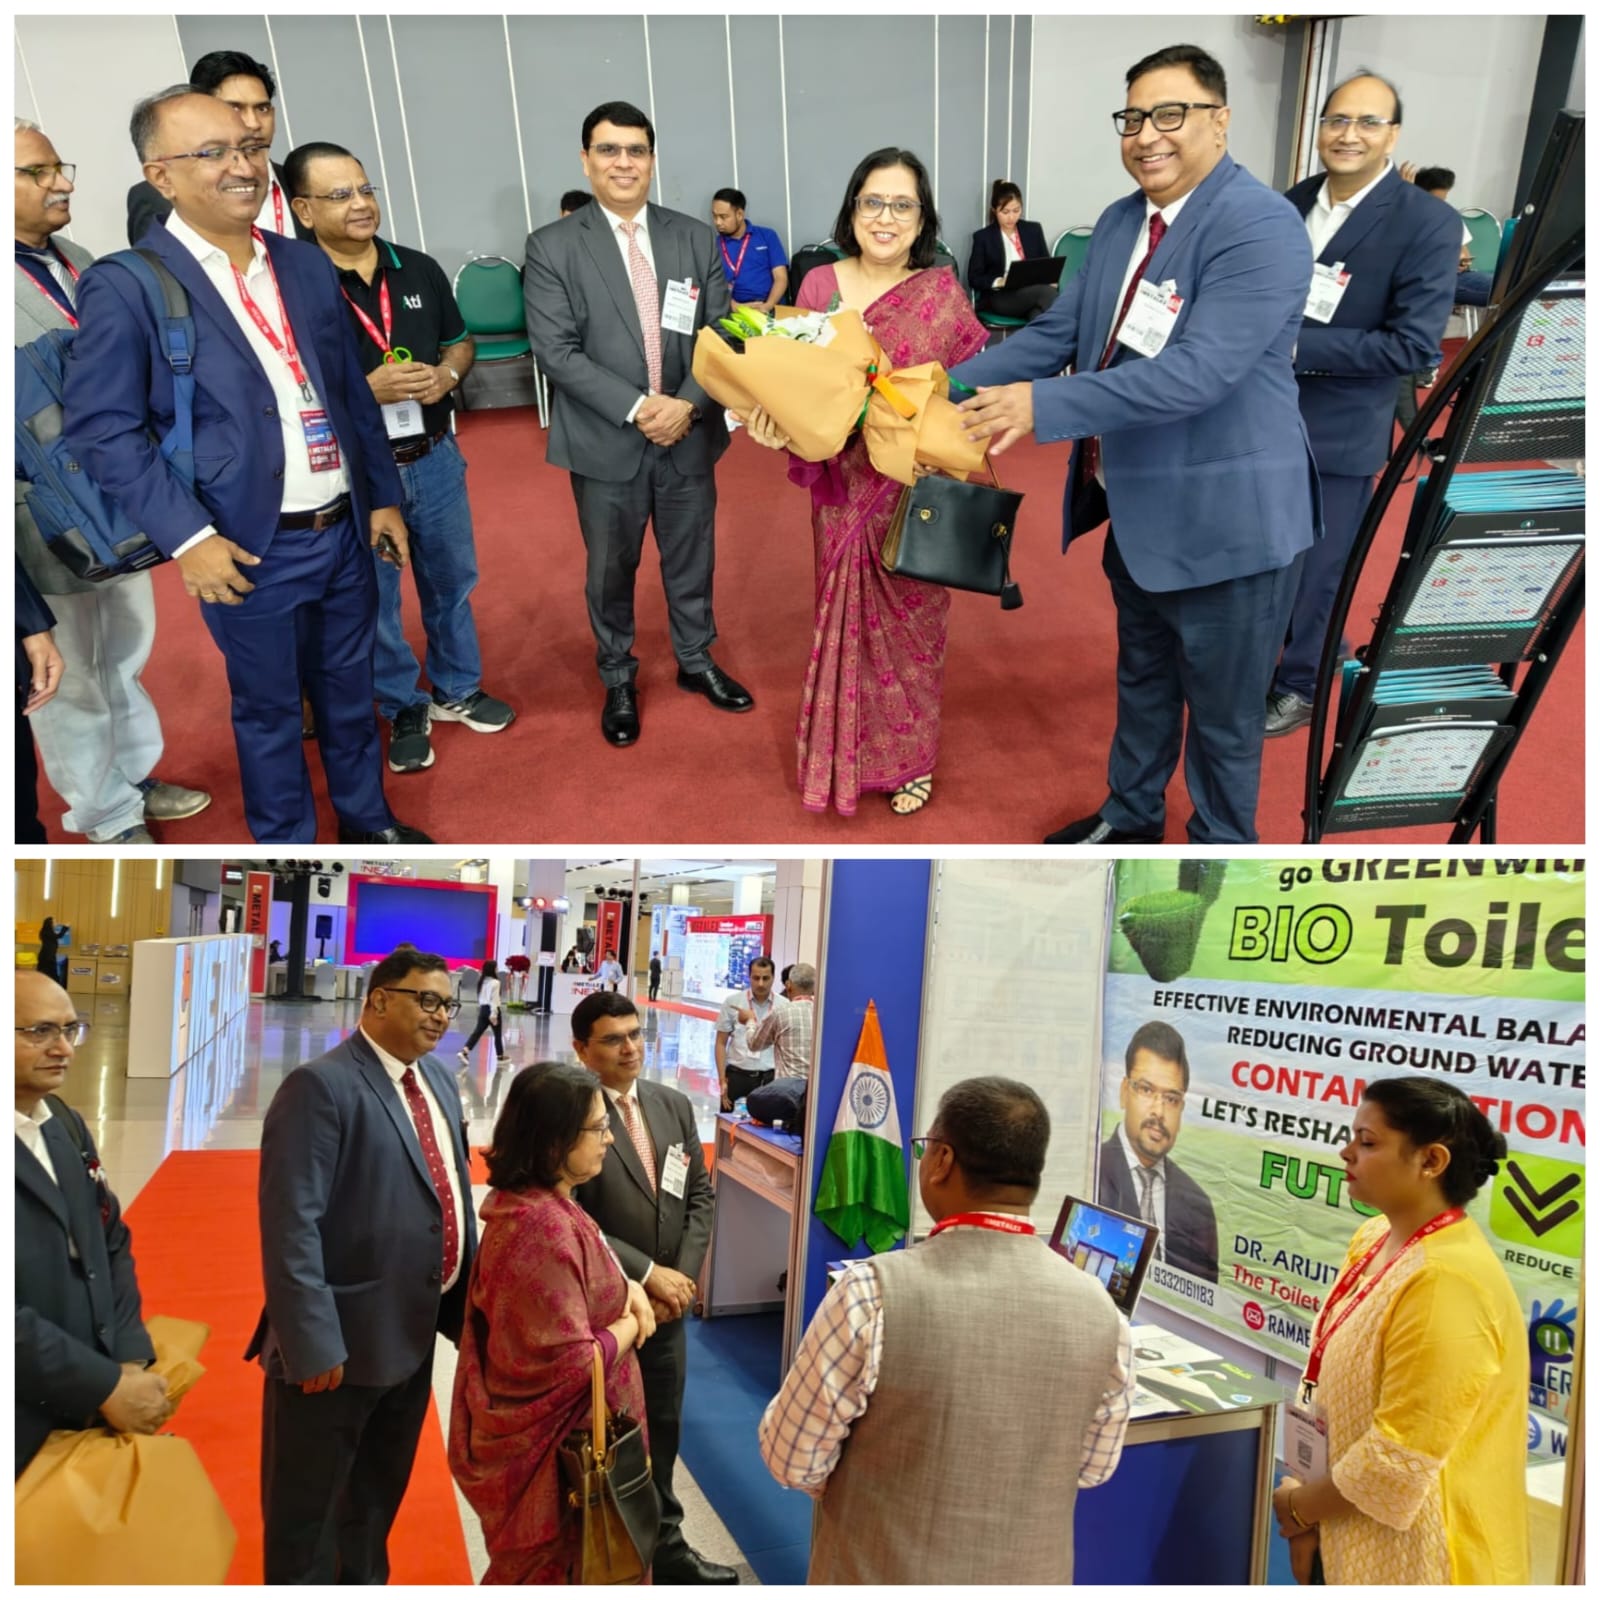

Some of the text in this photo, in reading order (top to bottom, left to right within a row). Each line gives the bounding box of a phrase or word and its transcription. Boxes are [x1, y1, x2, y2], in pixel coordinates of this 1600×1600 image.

[1279, 865, 1312, 891] go
[1228, 901, 1585, 972] BIO Toile
[1153, 990, 1250, 1015] EFFECTIVE
[1254, 998, 1487, 1039] ENVIRONMENTAL
[1227, 1026, 1342, 1057] REDUCING
[1349, 1040, 1477, 1074] GROUND
[1201, 1097, 1258, 1127] LET'S
[1234, 1234, 1267, 1263] DR.
[1504, 1249, 1574, 1279] REDUCE
[1154, 1266, 1214, 1307] 9332061183
[1232, 1263, 1264, 1292] The
[1269, 1276, 1322, 1313] Toilet
